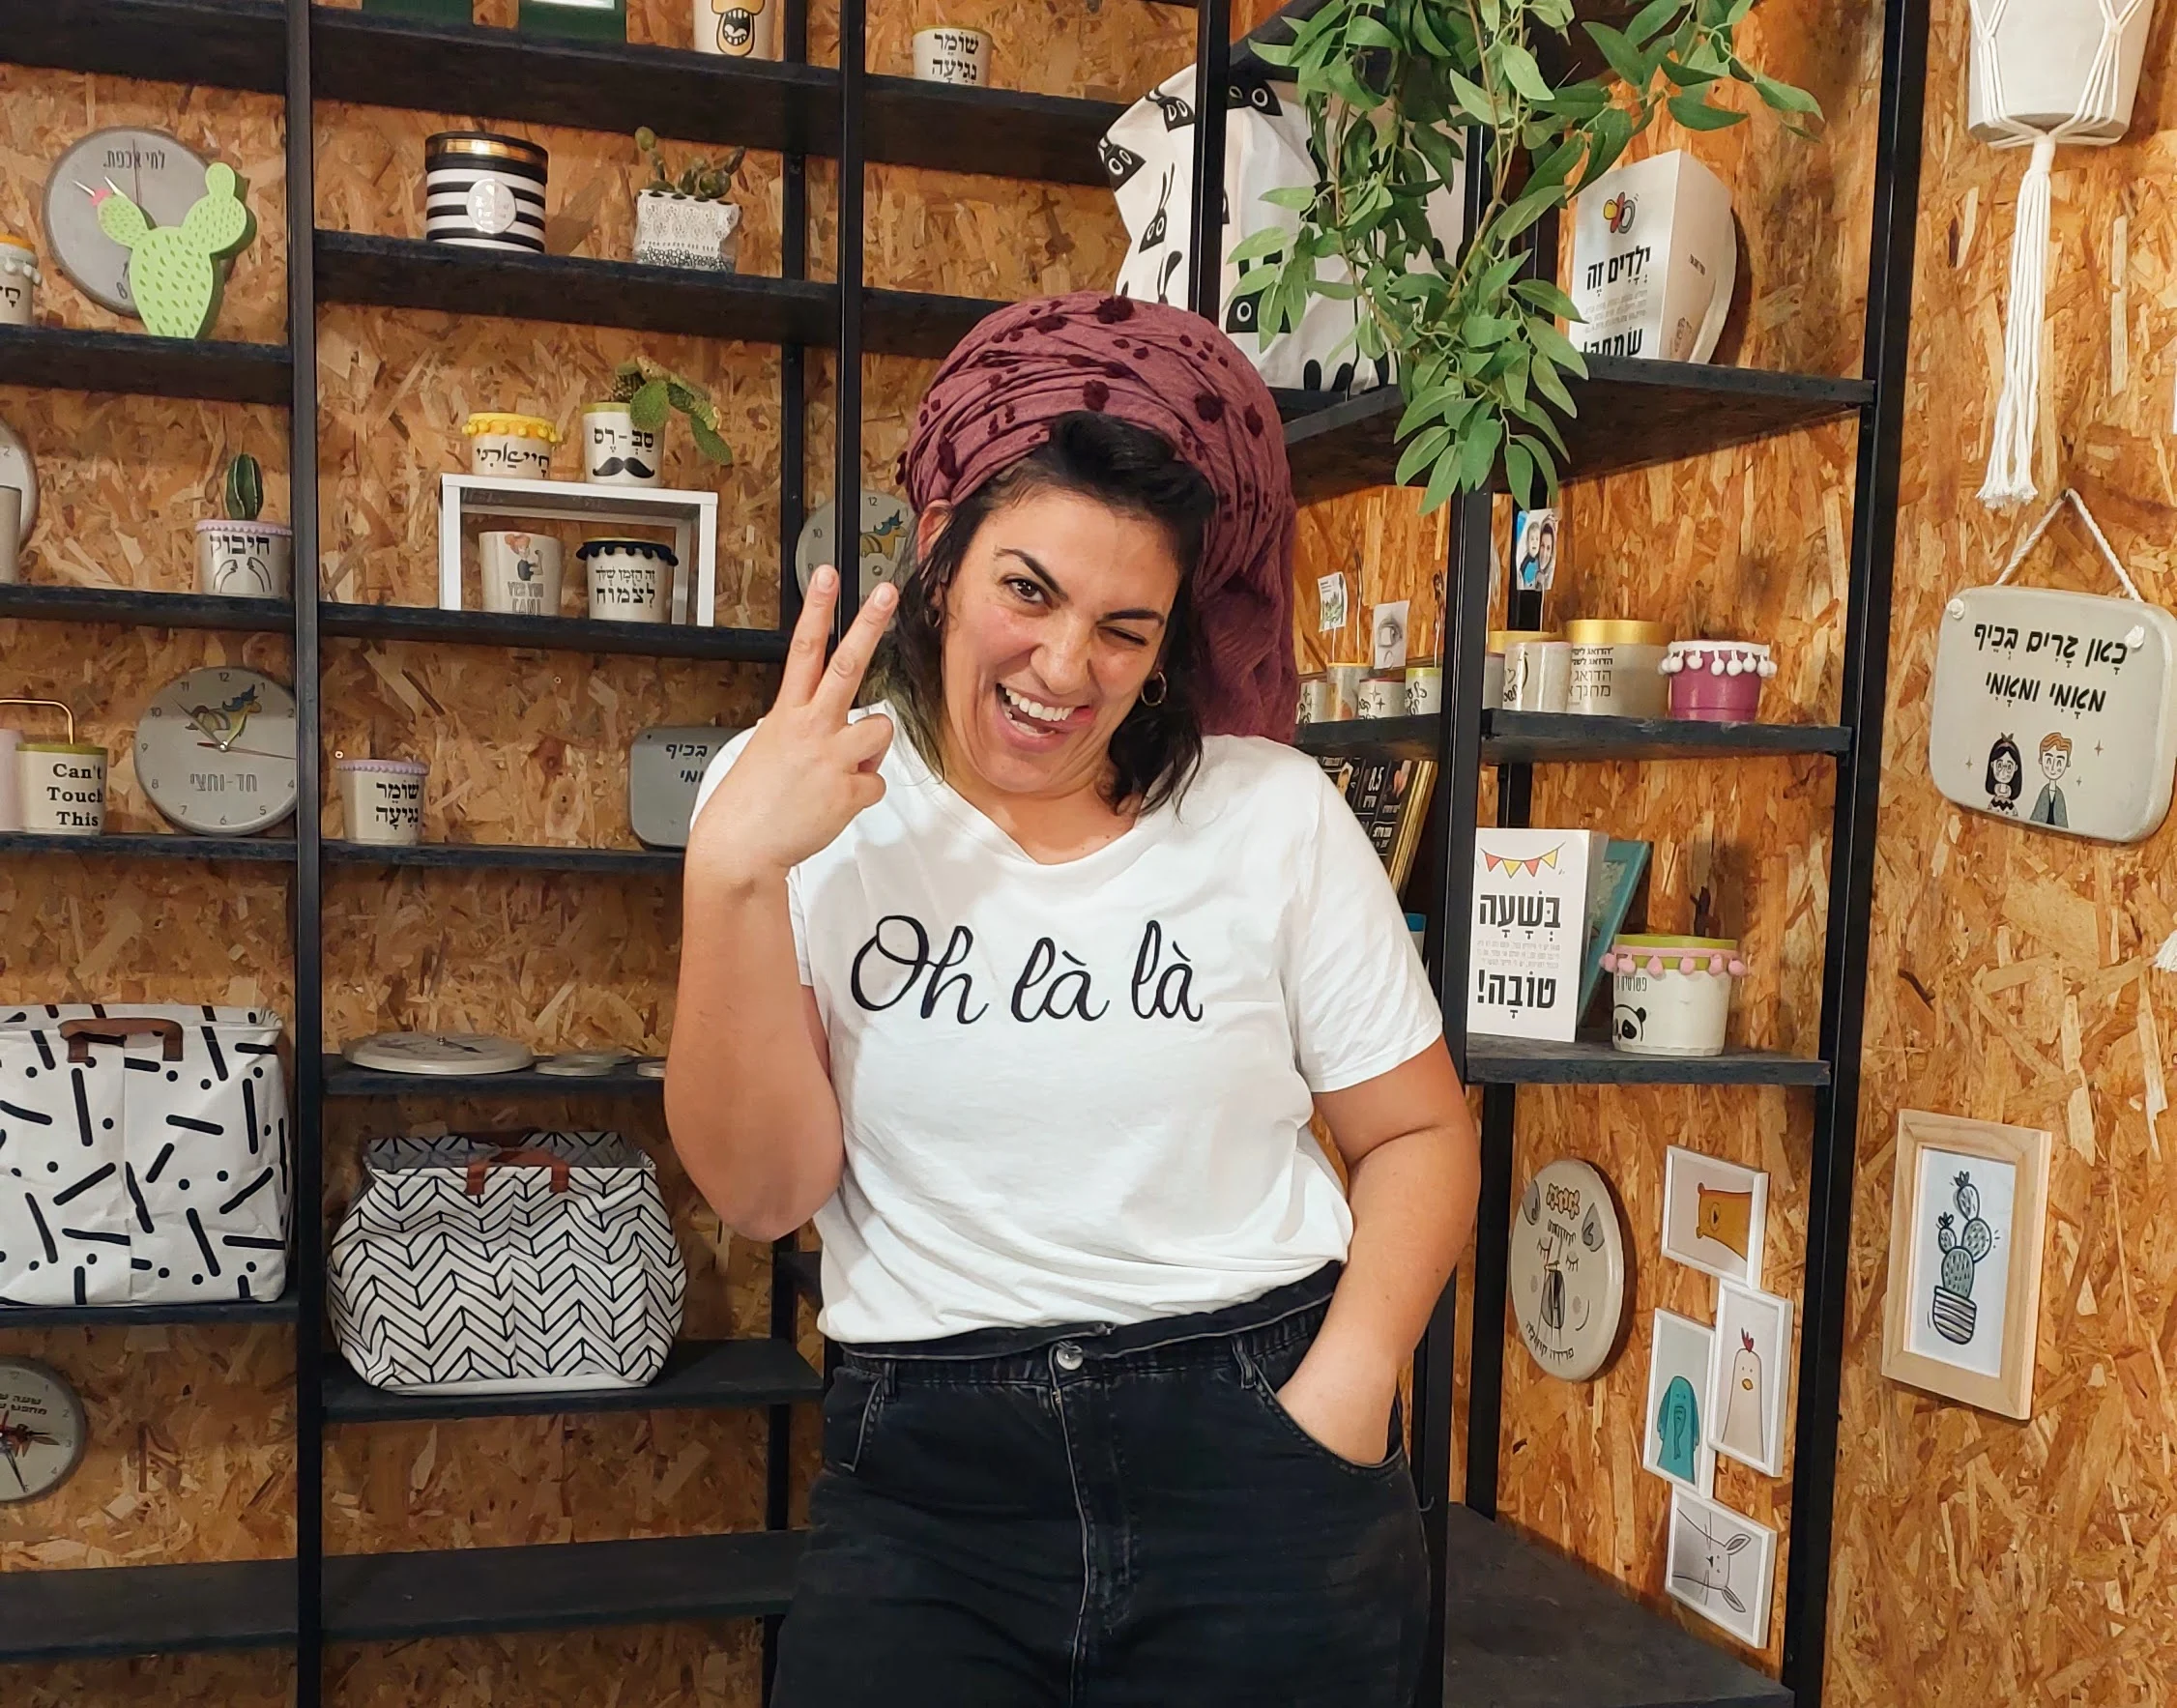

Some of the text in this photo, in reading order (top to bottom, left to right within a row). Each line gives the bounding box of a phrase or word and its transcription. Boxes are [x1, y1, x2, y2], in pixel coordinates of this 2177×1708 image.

[867, 496, 878, 507] 12
[812, 528, 823, 538] 10
[209, 534, 270, 558] חיבוק
[218, 672, 230, 682] 12
[1573, 669, 1612, 682] הדואג
[181, 680, 189, 692] 11
[260, 682, 266, 692] 1
[150, 707, 162, 717] 10
[287, 708, 295, 719] 2
[141, 742, 148, 754] 9
[52, 762, 102, 781] Can't
[151, 778, 160, 790] 8
[287, 777, 295, 789] 4
[46, 786, 103, 804] Touch
[181, 804, 189, 817] 7
[259, 804, 268, 817] 5
[56, 811, 100, 828] This
[219, 815, 227, 826] 6
[850, 914, 1204, 1025] Oh là là
